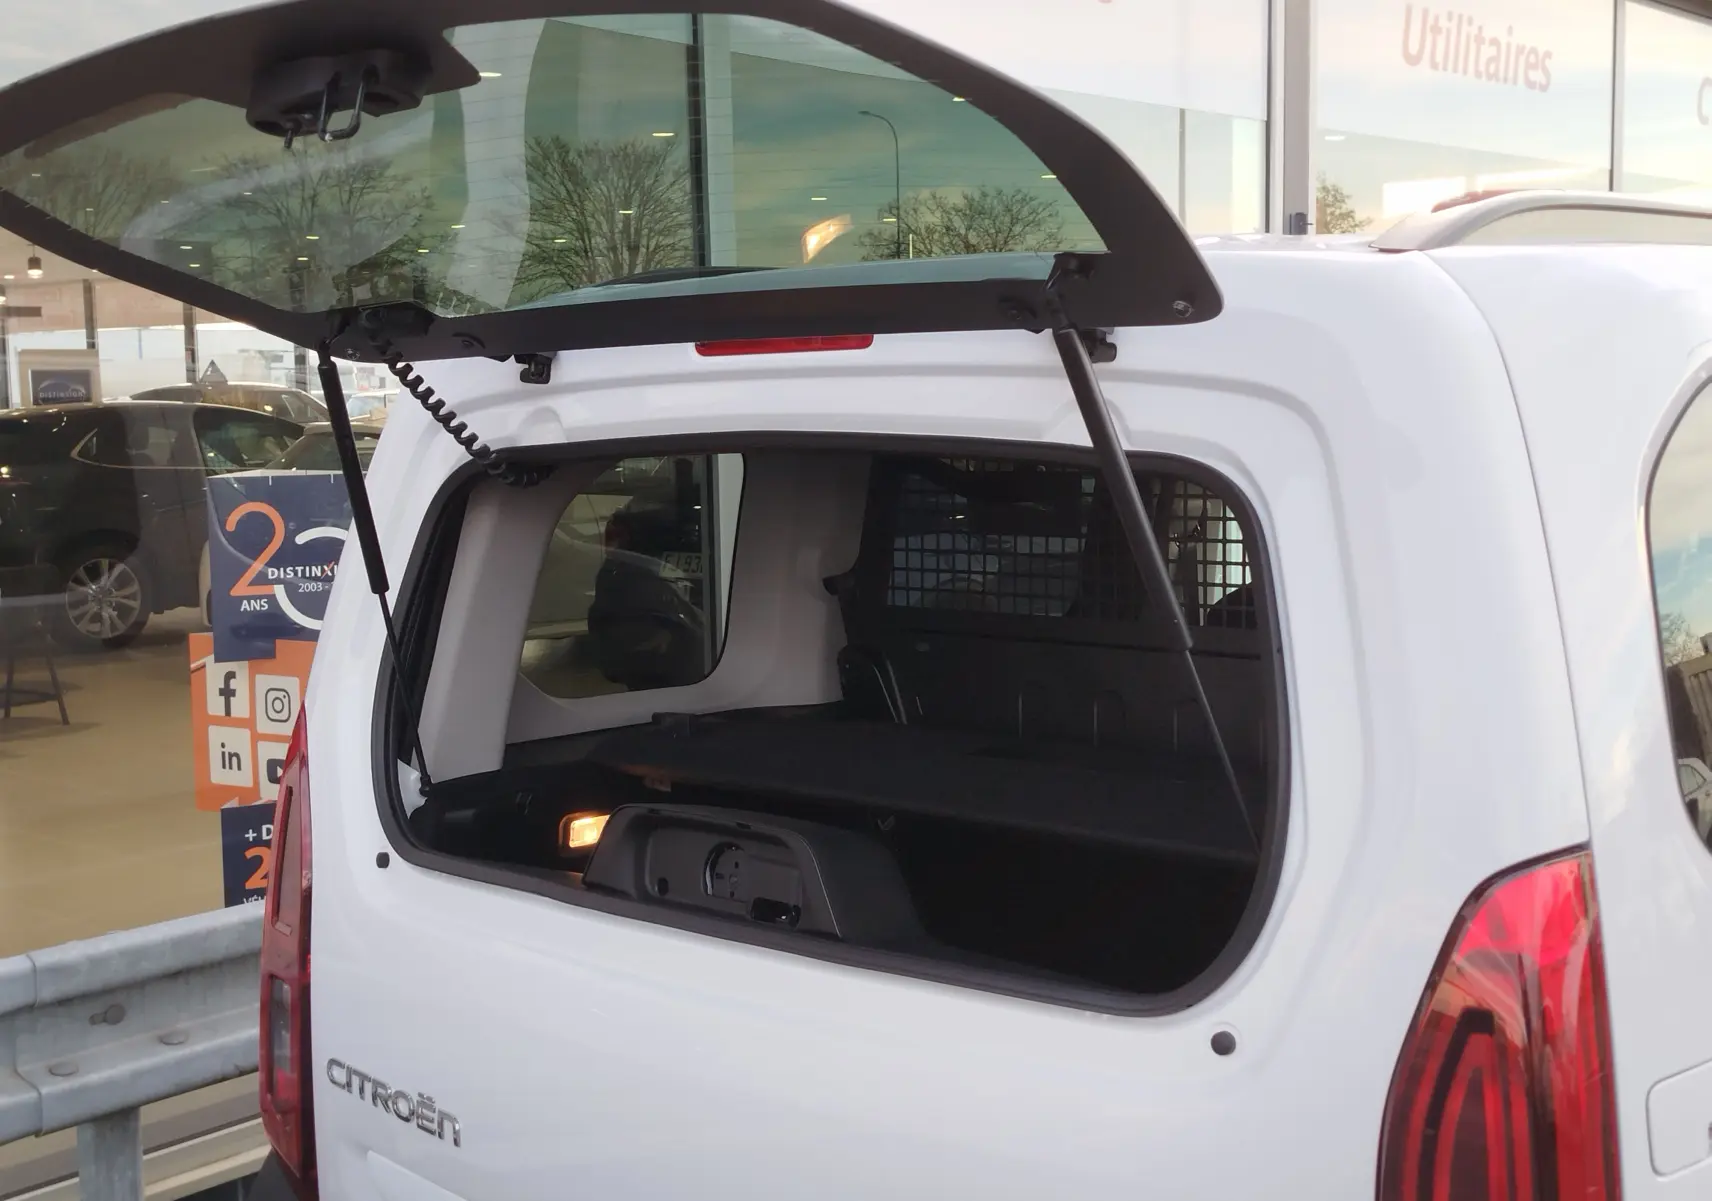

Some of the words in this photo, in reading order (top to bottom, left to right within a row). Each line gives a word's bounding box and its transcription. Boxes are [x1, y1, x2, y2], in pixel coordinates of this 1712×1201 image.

[1402, 3, 1553, 93] Utilitaires
[298, 582, 323, 593] 2003
[240, 598, 269, 612] ANS
[218, 670, 237, 717] f
[221, 742, 242, 771] in
